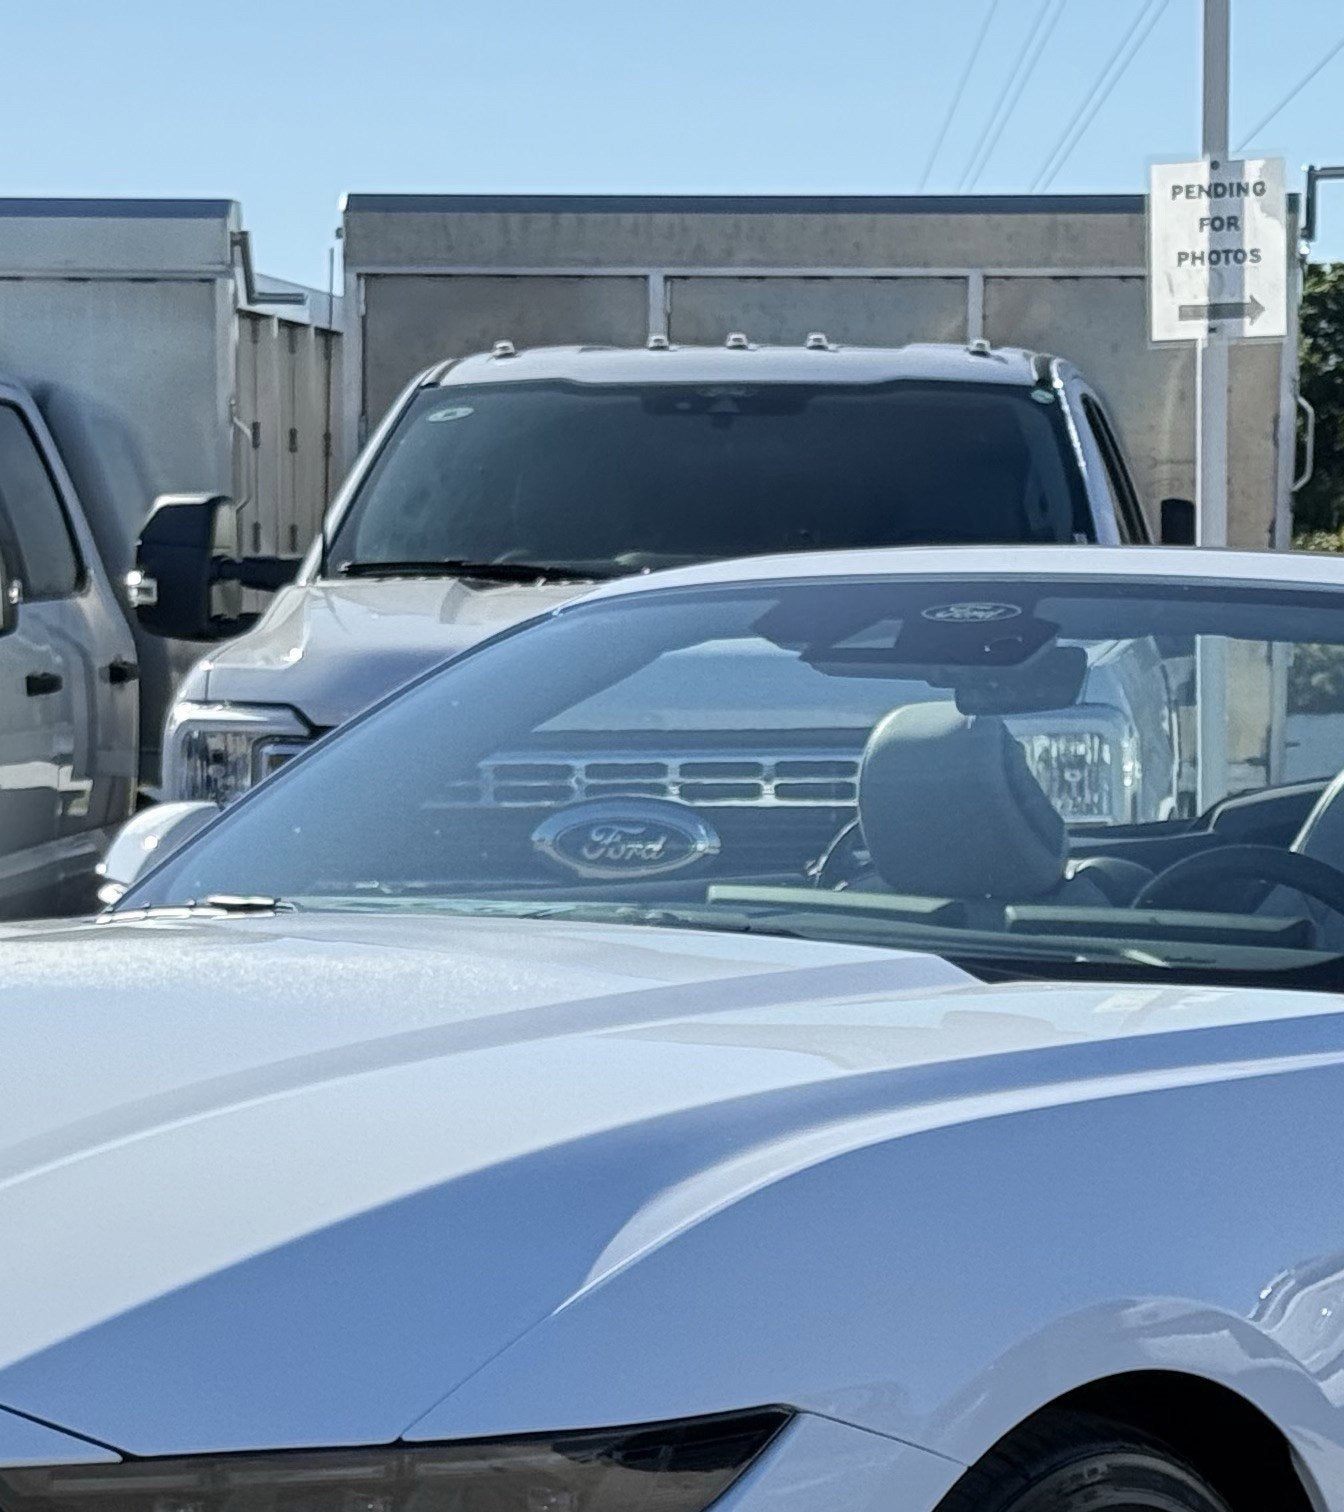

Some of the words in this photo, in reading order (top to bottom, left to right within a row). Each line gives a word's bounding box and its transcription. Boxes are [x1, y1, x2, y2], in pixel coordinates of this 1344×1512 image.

[1171, 181, 1266, 200] PENDING
[1199, 216, 1240, 233] FOR
[1177, 248, 1262, 267] PHOTOS
[582, 825, 668, 860] Ford
